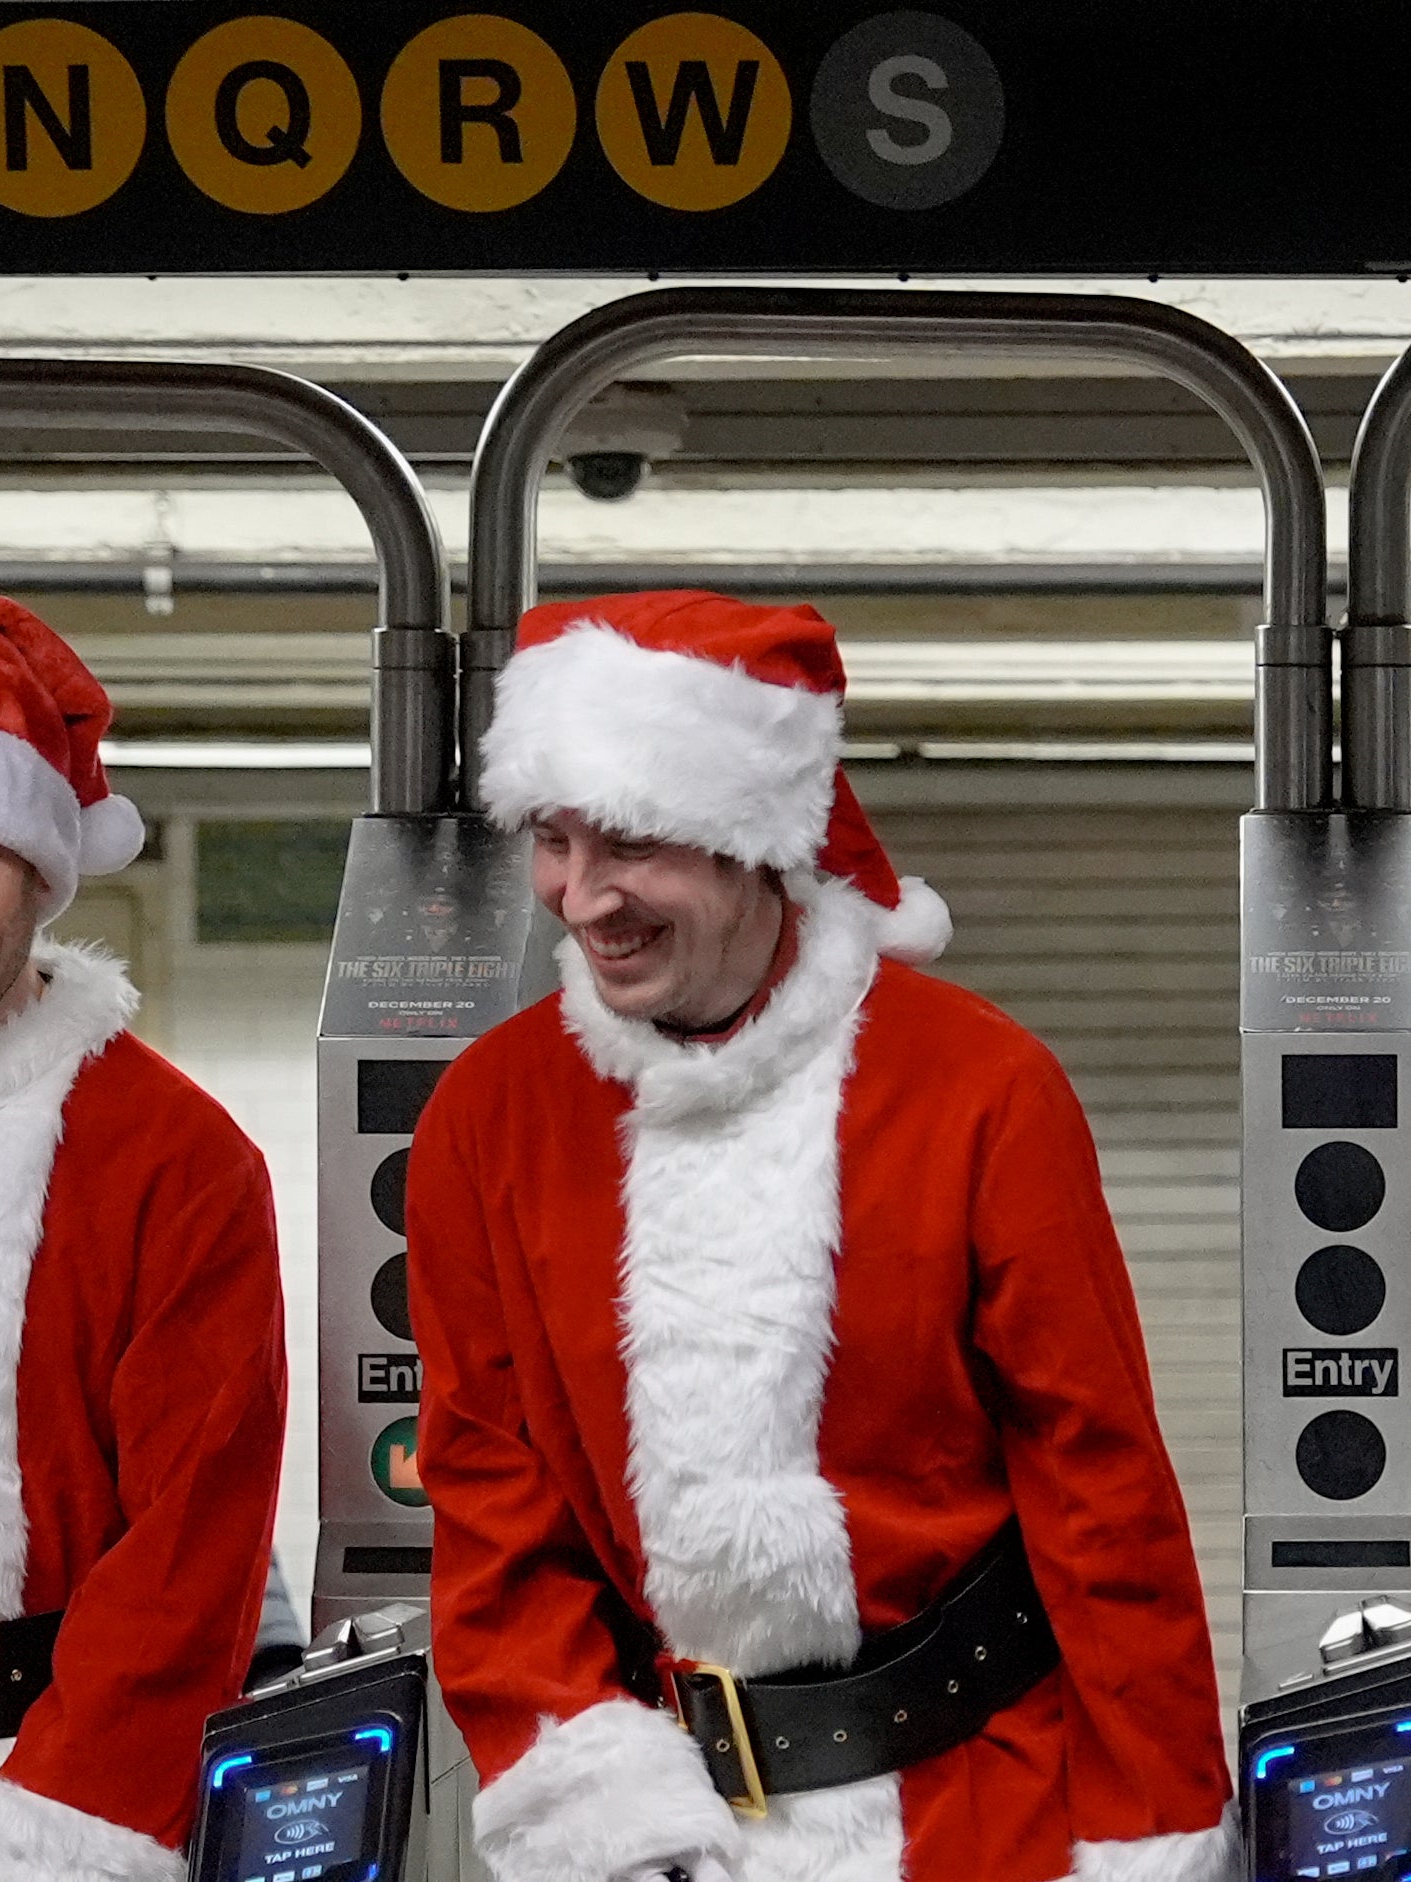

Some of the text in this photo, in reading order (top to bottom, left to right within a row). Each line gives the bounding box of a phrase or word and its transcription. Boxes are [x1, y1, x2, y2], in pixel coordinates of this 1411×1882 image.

[2, 64, 93, 172] N
[213, 59, 314, 170] Q
[438, 59, 523, 165] R
[624, 60, 760, 166] W
[865, 54, 954, 166] S
[337, 961, 521, 979] THE SIX TRIPLE EIGHT
[1249, 956, 1411, 974] THE SIX TRIPLE EIG
[367, 1001, 475, 1009] DECEMBER 20
[1285, 995, 1392, 1004] DECEMBER 20
[379, 1017, 459, 1029] NETFLIX
[1299, 1012, 1379, 1024] NETFLIX
[361, 1357, 423, 1392] Ent
[1286, 1351, 1394, 1395] Entry
[266, 1791, 343, 1819] OMNY
[1312, 1781, 1392, 1810] OMNY
[264, 1841, 335, 1865] TAP HERE
[1316, 1832, 1388, 1855] TAP HERE
